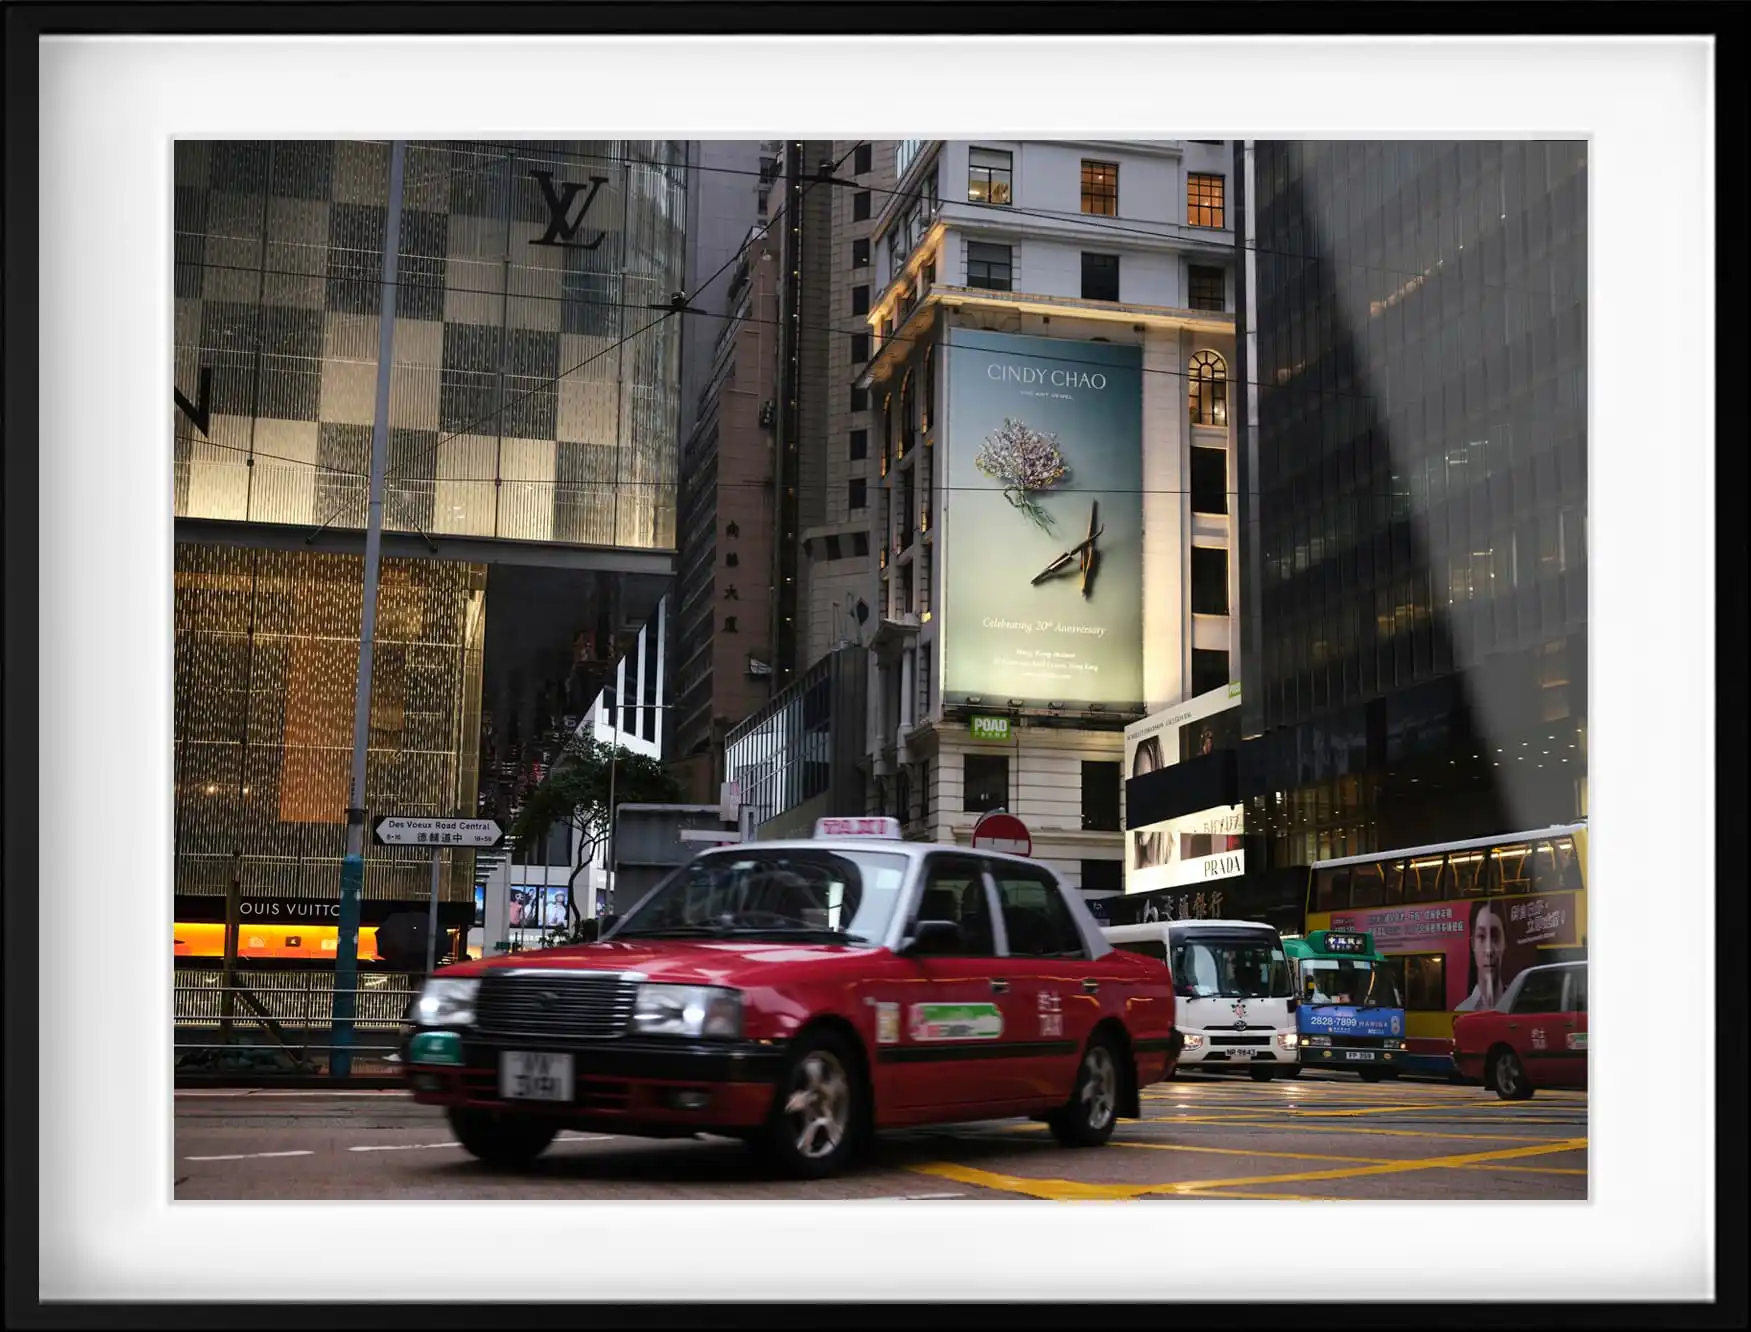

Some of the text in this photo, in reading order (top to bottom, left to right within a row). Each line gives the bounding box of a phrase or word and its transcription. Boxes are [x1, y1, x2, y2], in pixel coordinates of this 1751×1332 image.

[987, 363, 1107, 390] CINDY CHAO
[983, 616, 1033, 633] Celebrating
[1055, 621, 1107, 638] Anniversary
[974, 717, 1008, 732] POAD
[388, 820, 490, 831] Des Voeux Road Central
[1204, 855, 1241, 878] PRADA
[239, 902, 340, 917] OUIS VUITTO
